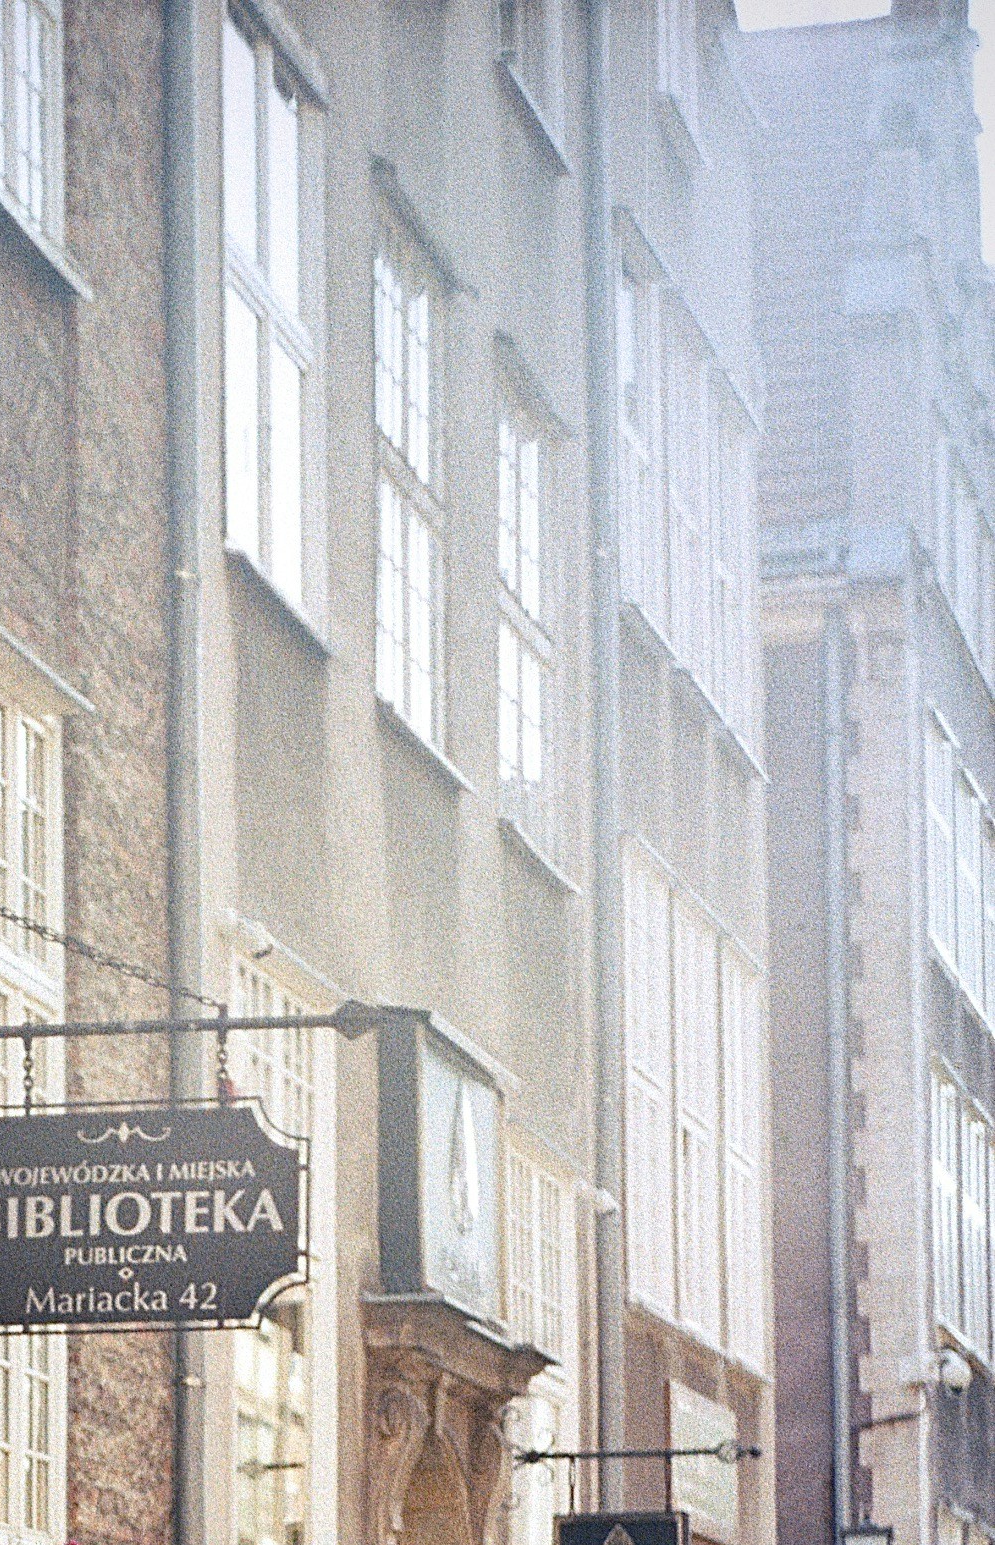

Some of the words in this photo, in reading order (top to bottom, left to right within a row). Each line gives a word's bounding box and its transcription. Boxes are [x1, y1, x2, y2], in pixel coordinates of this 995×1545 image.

[156, 1164, 164, 1182] I
[169, 1160, 256, 1183] MIEJSKA
[64, 1244, 188, 1266] PUBLICZNA
[26, 1285, 168, 1315] Mariacka
[179, 1282, 218, 1310] 42
